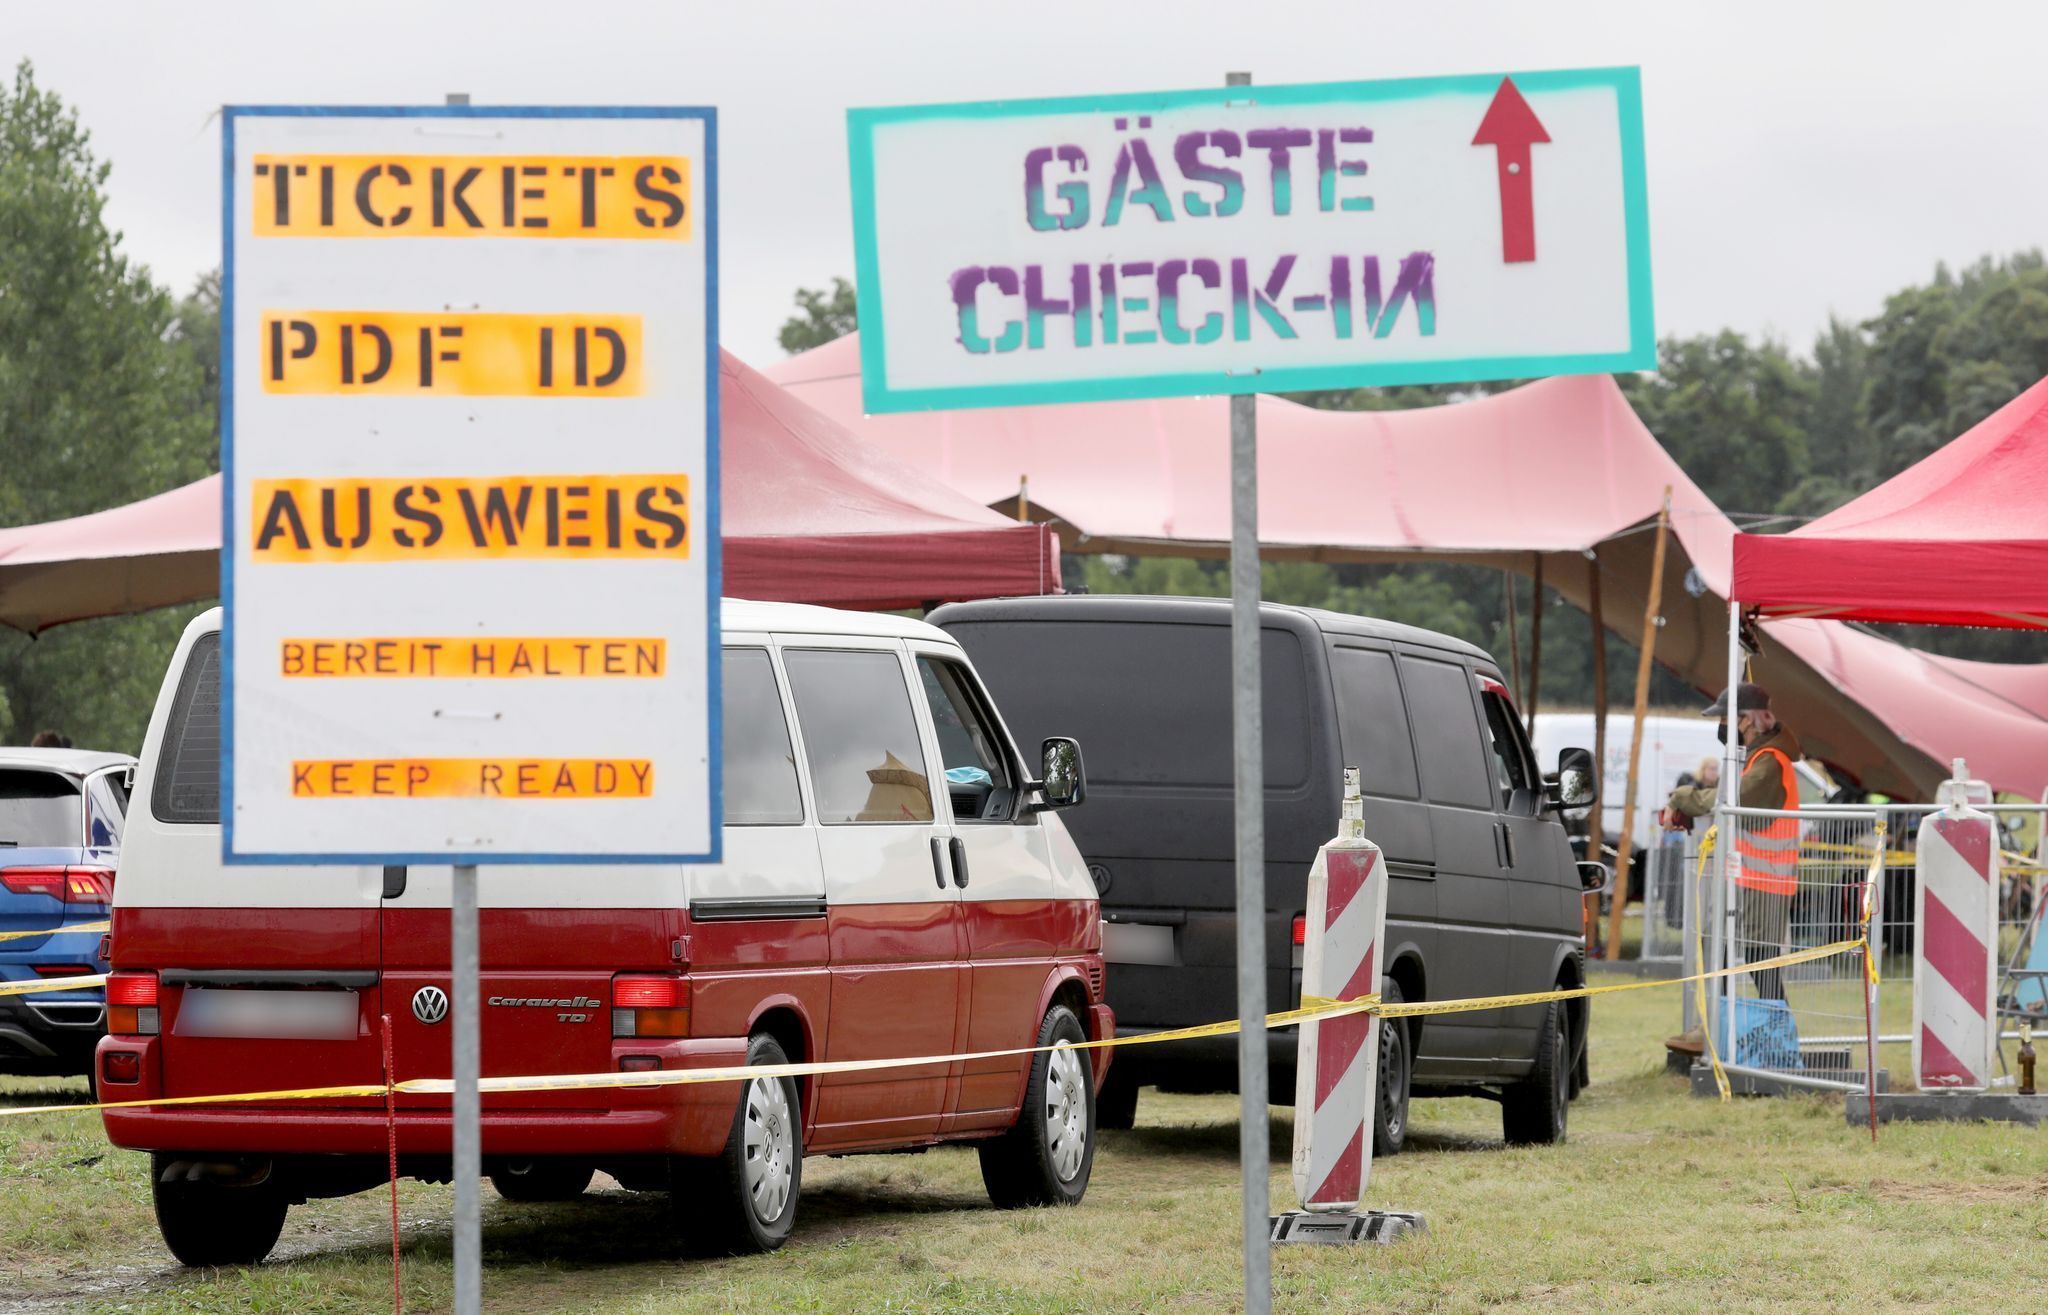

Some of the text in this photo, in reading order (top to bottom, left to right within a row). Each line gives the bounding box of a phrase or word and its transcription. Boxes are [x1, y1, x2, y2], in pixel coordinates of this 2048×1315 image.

[255, 164, 685, 228] TICKETS
[1025, 116, 1375, 231] GÄSTE
[269, 320, 627, 388] PDF ID
[255, 485, 687, 551] AUSWEIS
[282, 642, 660, 677] BEREIT HALTEN
[292, 762, 653, 797] KEEP READY
[487, 996, 601, 1008] Caravelle
